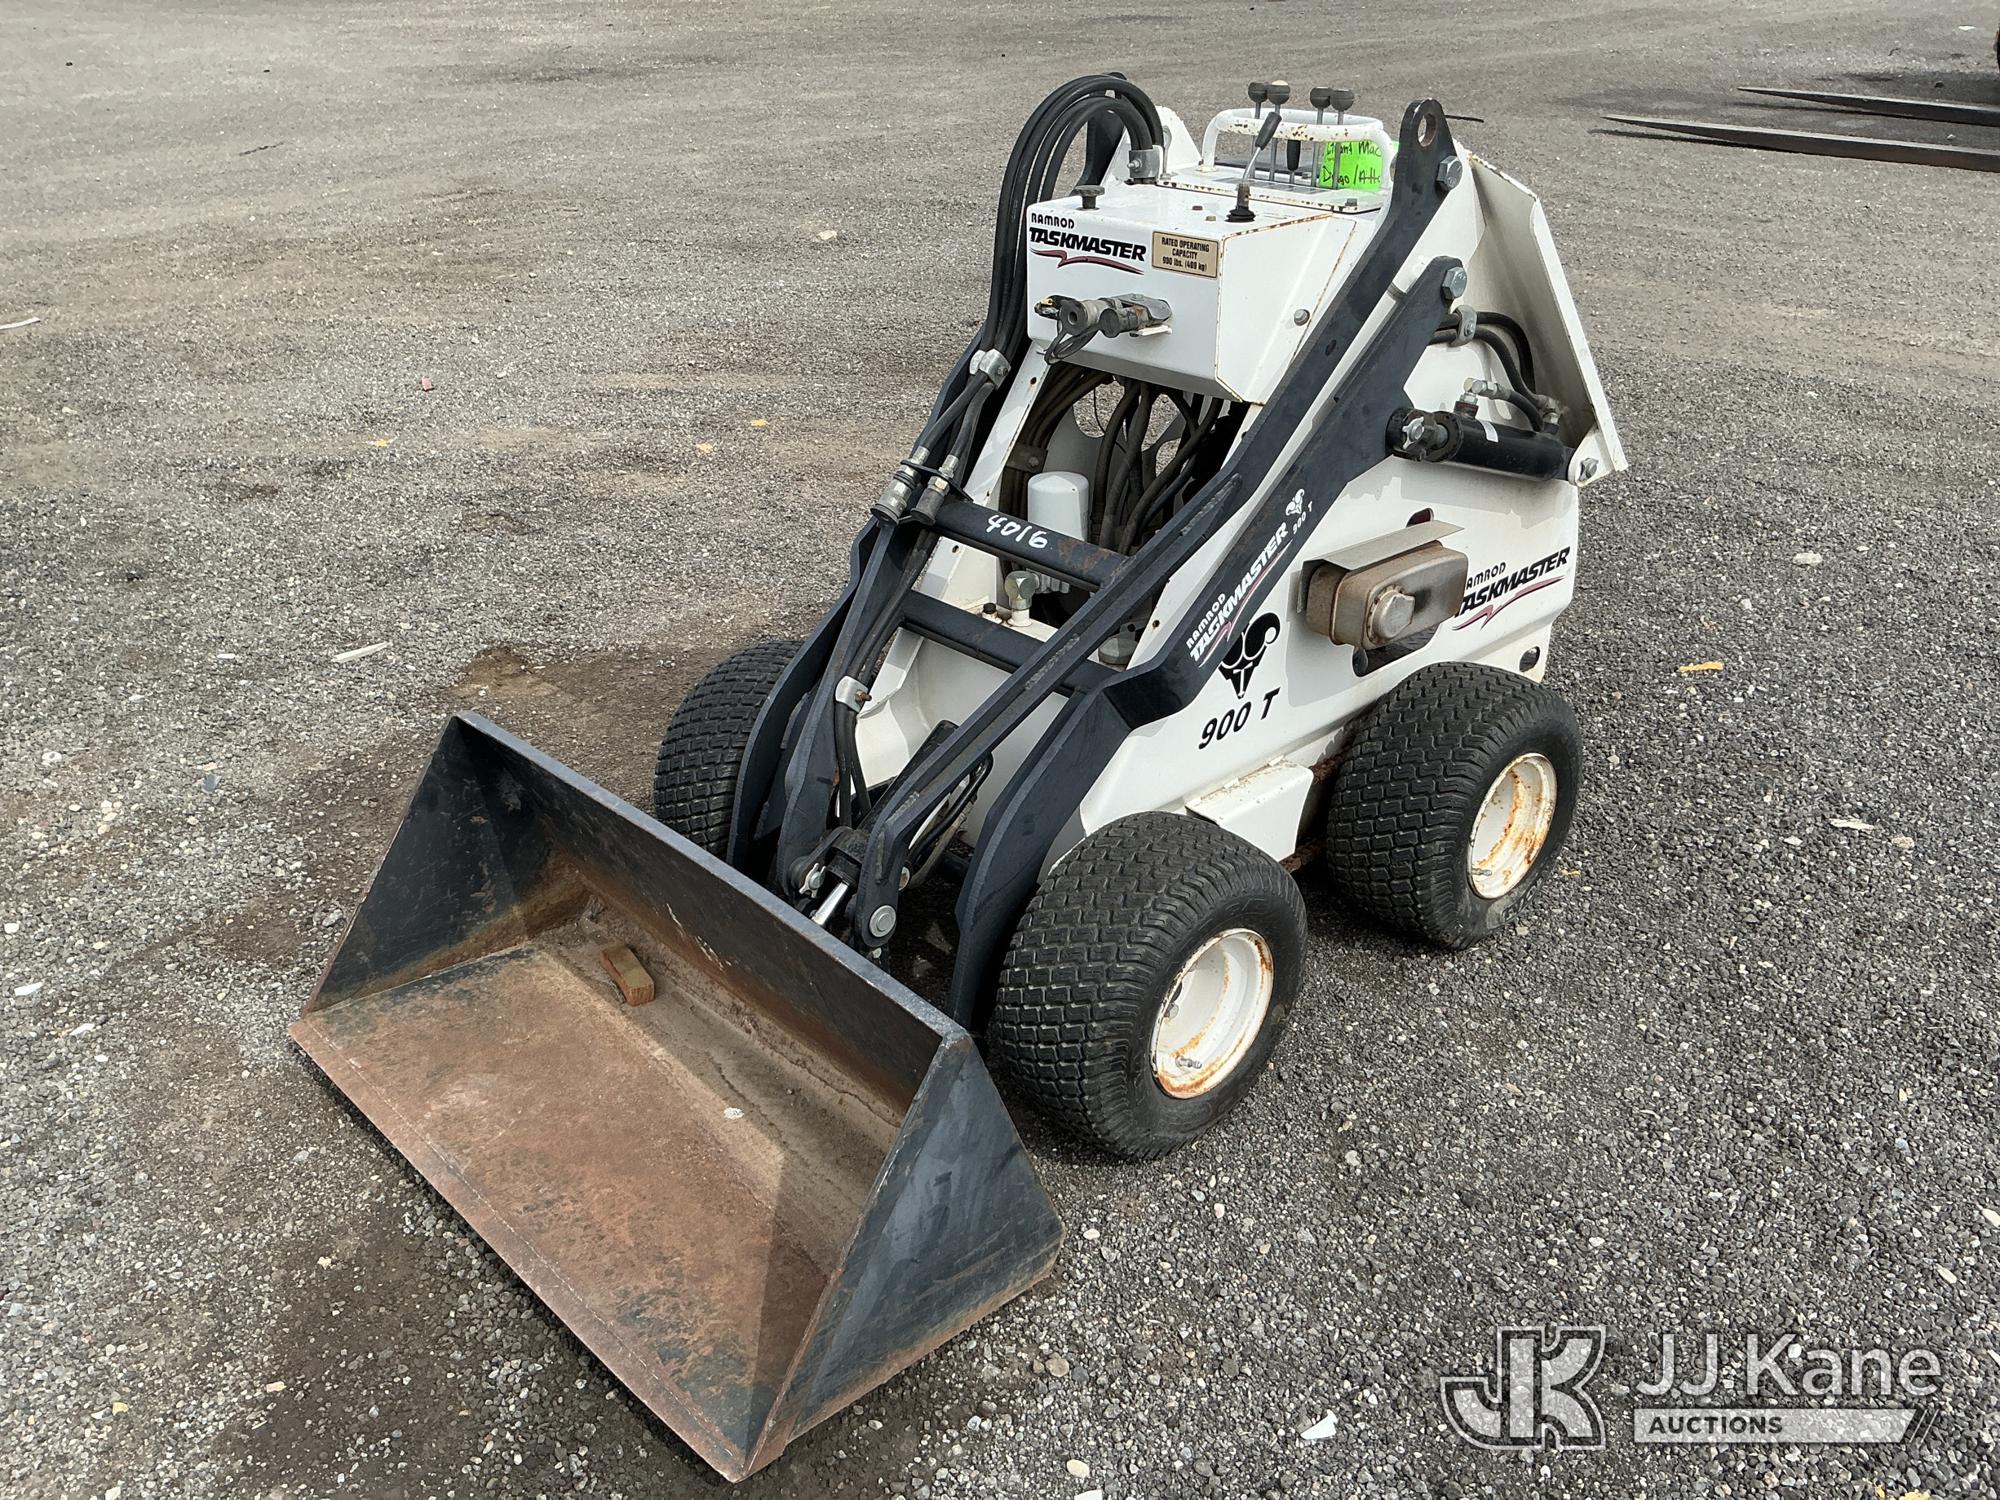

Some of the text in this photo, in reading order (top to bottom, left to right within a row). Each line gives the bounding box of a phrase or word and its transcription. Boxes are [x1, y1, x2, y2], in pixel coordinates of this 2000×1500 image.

[1031, 212, 1075, 229] RAMROD
[1029, 226, 1147, 262] TASKMASTER
[1161, 237, 1210, 253] RATED OPERATING
[1172, 248, 1198, 260] CAPACITY
[986, 514, 1048, 549] 4016
[1292, 500, 1313, 535] 900 T
[1190, 522, 1289, 662] TASKMASTER
[1466, 561, 1507, 590] AMROD
[1186, 593, 1226, 649] RAMROD
[1198, 687, 1281, 750] 900 T
